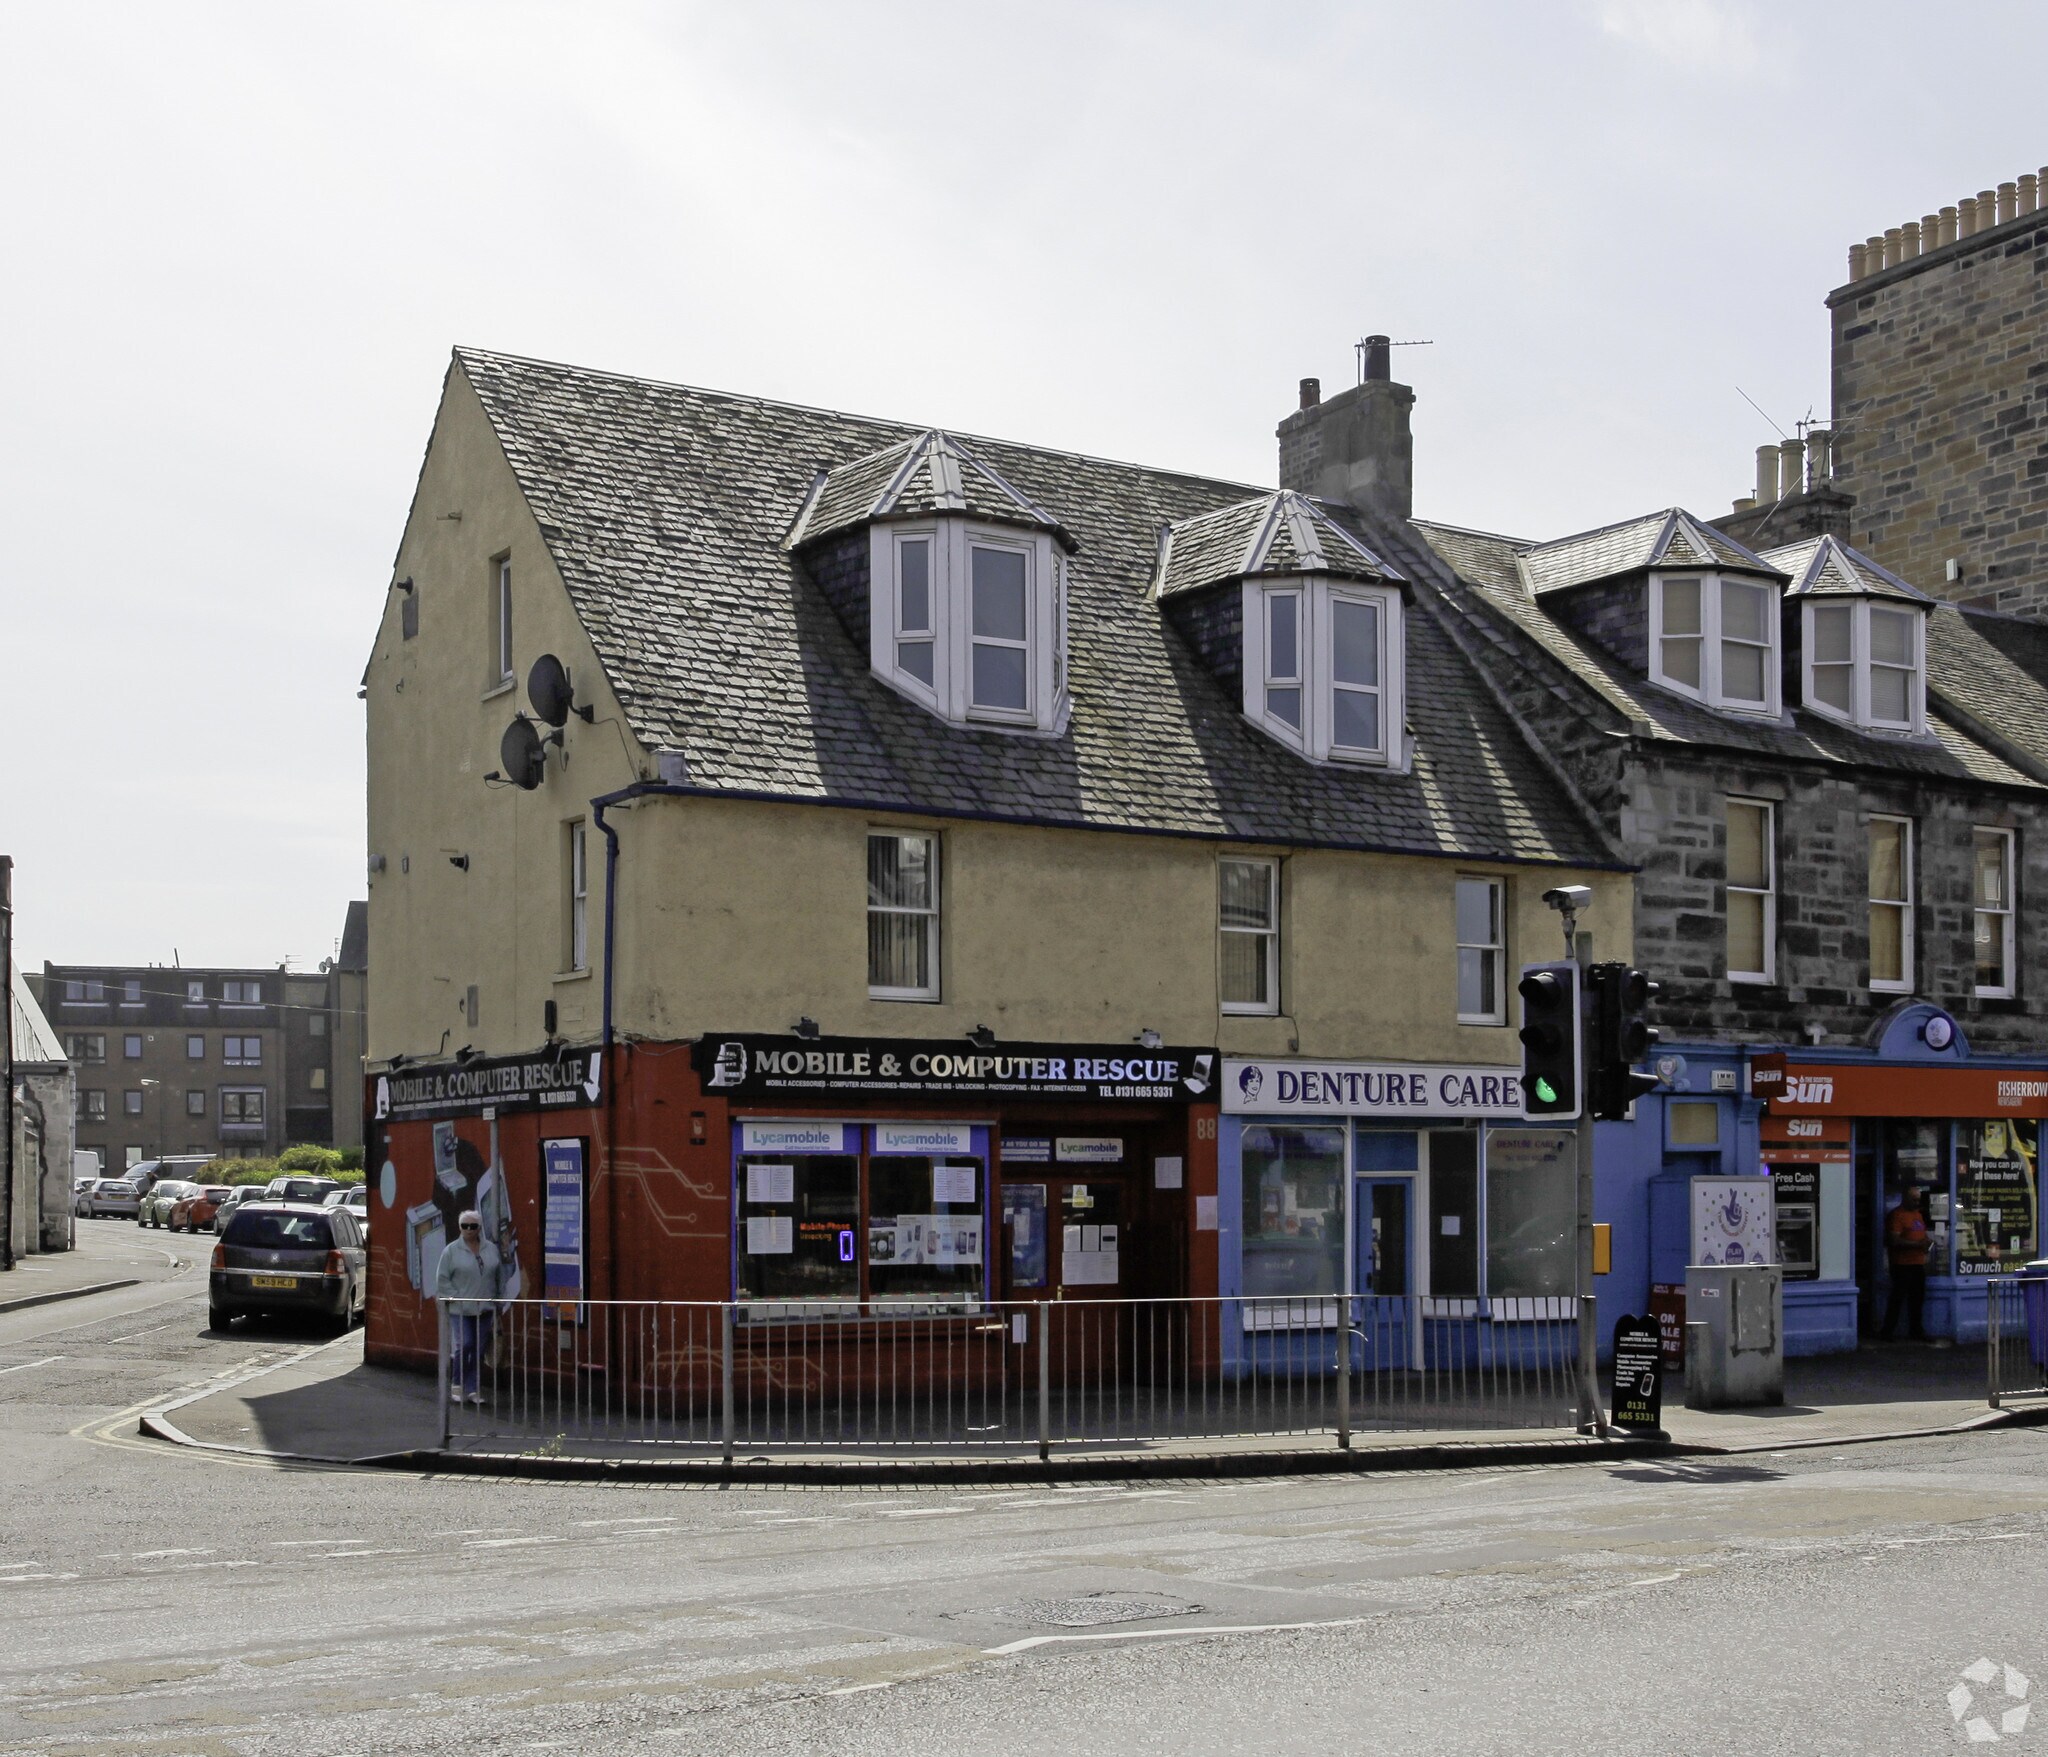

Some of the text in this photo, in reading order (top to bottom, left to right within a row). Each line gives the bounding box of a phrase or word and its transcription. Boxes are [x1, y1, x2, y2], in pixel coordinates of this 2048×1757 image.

[755, 1050, 1179, 1082] MOBILE & COMPUTER RESCUE
[390, 1077, 433, 1103] MOBILE
[435, 1075, 444, 1099] &
[447, 1066, 521, 1100] COMPUTER
[523, 1060, 583, 1090] RESCUE
[766, 1079, 787, 1087] MOBILE
[830, 1080, 860, 1088] COMPUTER
[1115, 1086, 1133, 1097] 0131
[1135, 1086, 1151, 1098] 665
[1152, 1086, 1173, 1098] 5331
[1277, 1070, 1522, 1108] DENTURE CARE
[1776, 1076, 1834, 1104] Sun
[1998, 1081, 2048, 1097] FISHERROW
[1197, 1118, 1217, 1140] 88
[1786, 1119, 1823, 1136] Sun
[753, 1130, 831, 1146] Lycamobile
[885, 1131, 958, 1146] Lycamobile
[1060, 1141, 1118, 1154] Lycamobile
[1969, 1160, 2023, 1170] Now you can pay
[1775, 1172, 1815, 1183] Free Cash
[1984, 1172, 2002, 1181] these
[2003, 1172, 2020, 1181] here!
[1959, 1260, 1972, 1273] So
[1974, 1260, 2001, 1273] much
[1660, 1313, 1676, 1323] ON
[1661, 1327, 1680, 1338] ALE
[1626, 1401, 1647, 1410] 0131
[1617, 1411, 1655, 1422] 665 5331
